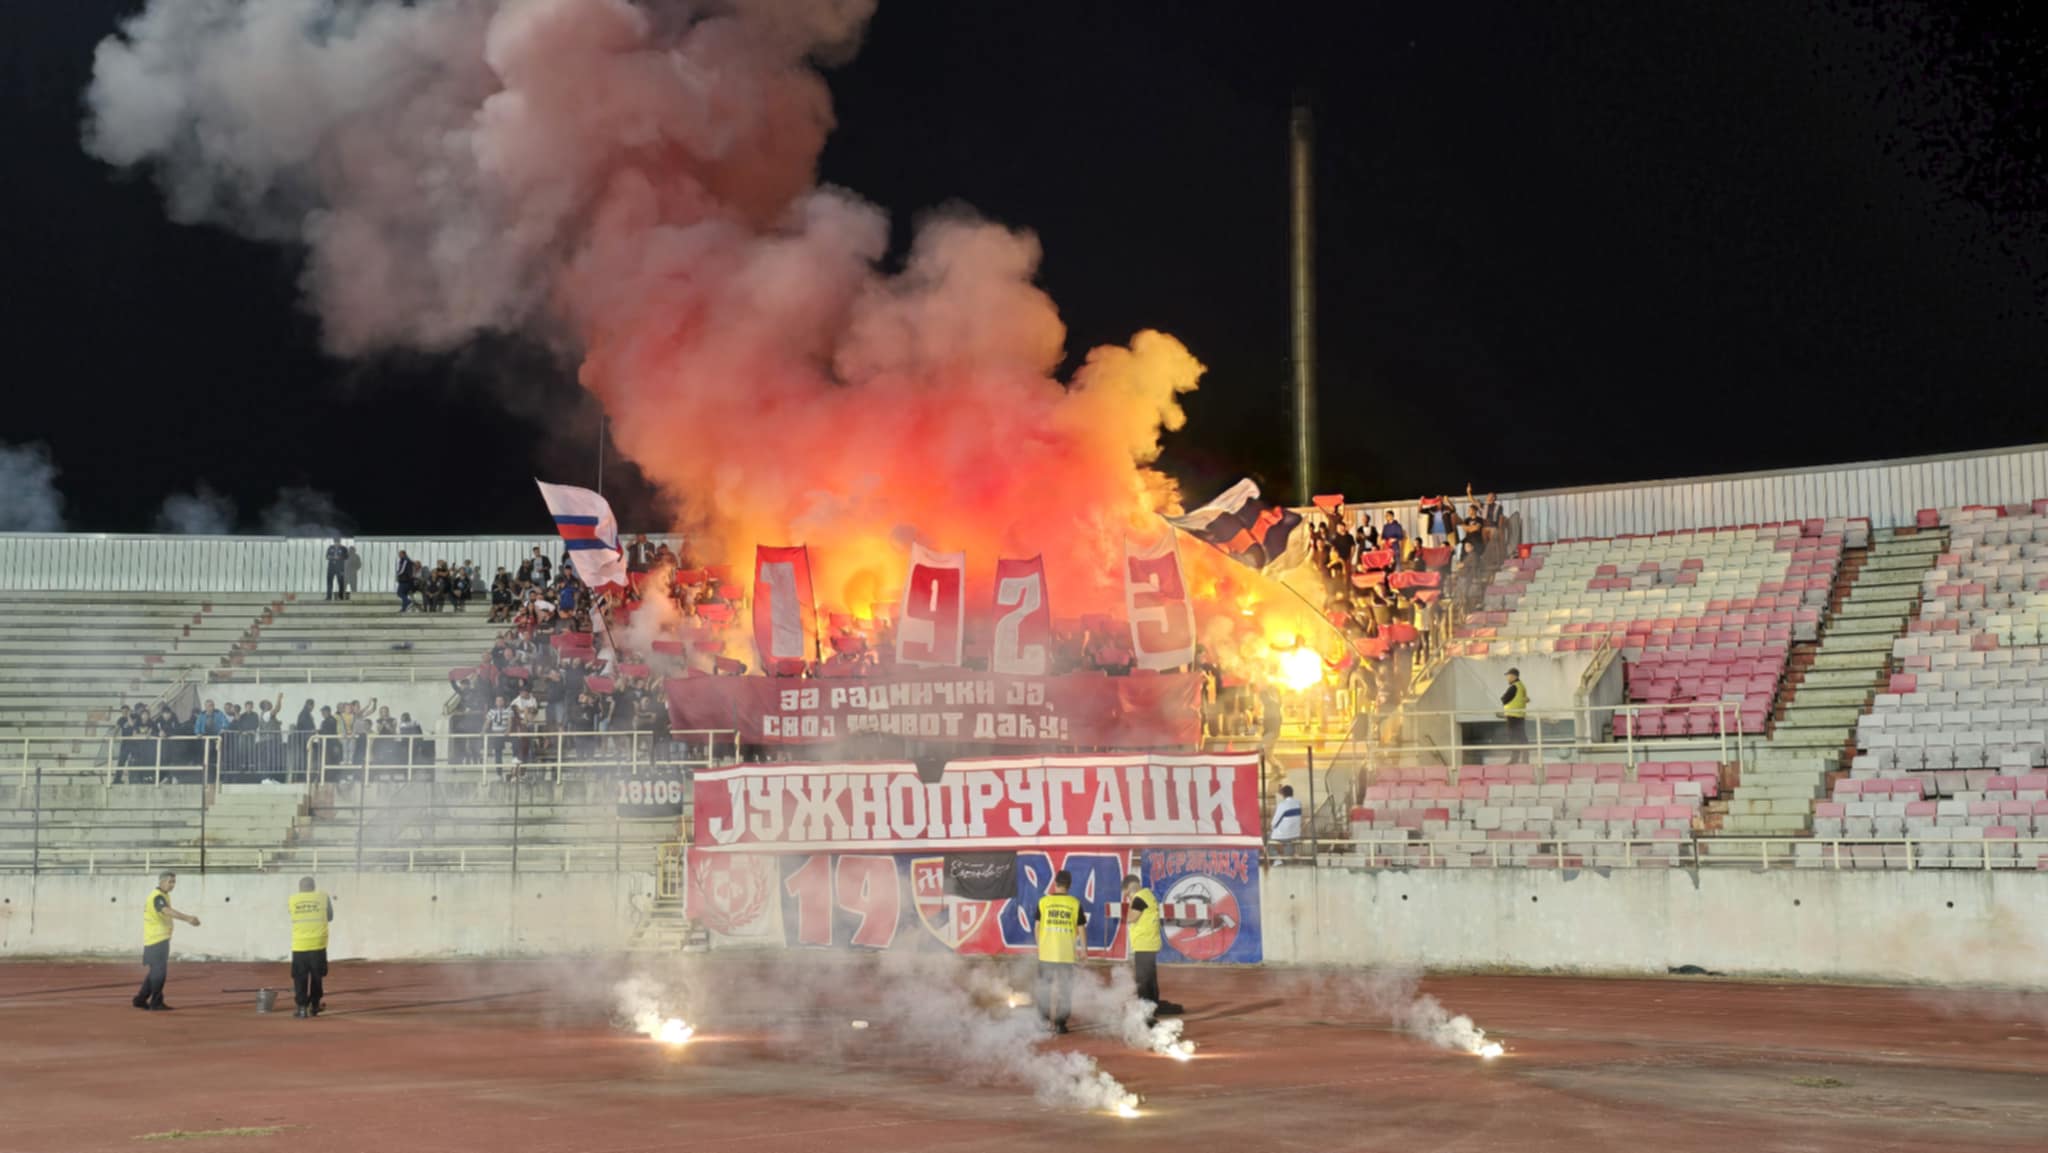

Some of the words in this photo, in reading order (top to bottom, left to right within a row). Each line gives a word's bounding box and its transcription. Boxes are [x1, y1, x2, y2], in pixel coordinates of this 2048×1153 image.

[617, 780, 682, 805] 18106
[708, 767, 1242, 844] ЈУЖНОПРУГАШИ
[784, 854, 901, 948] 19
